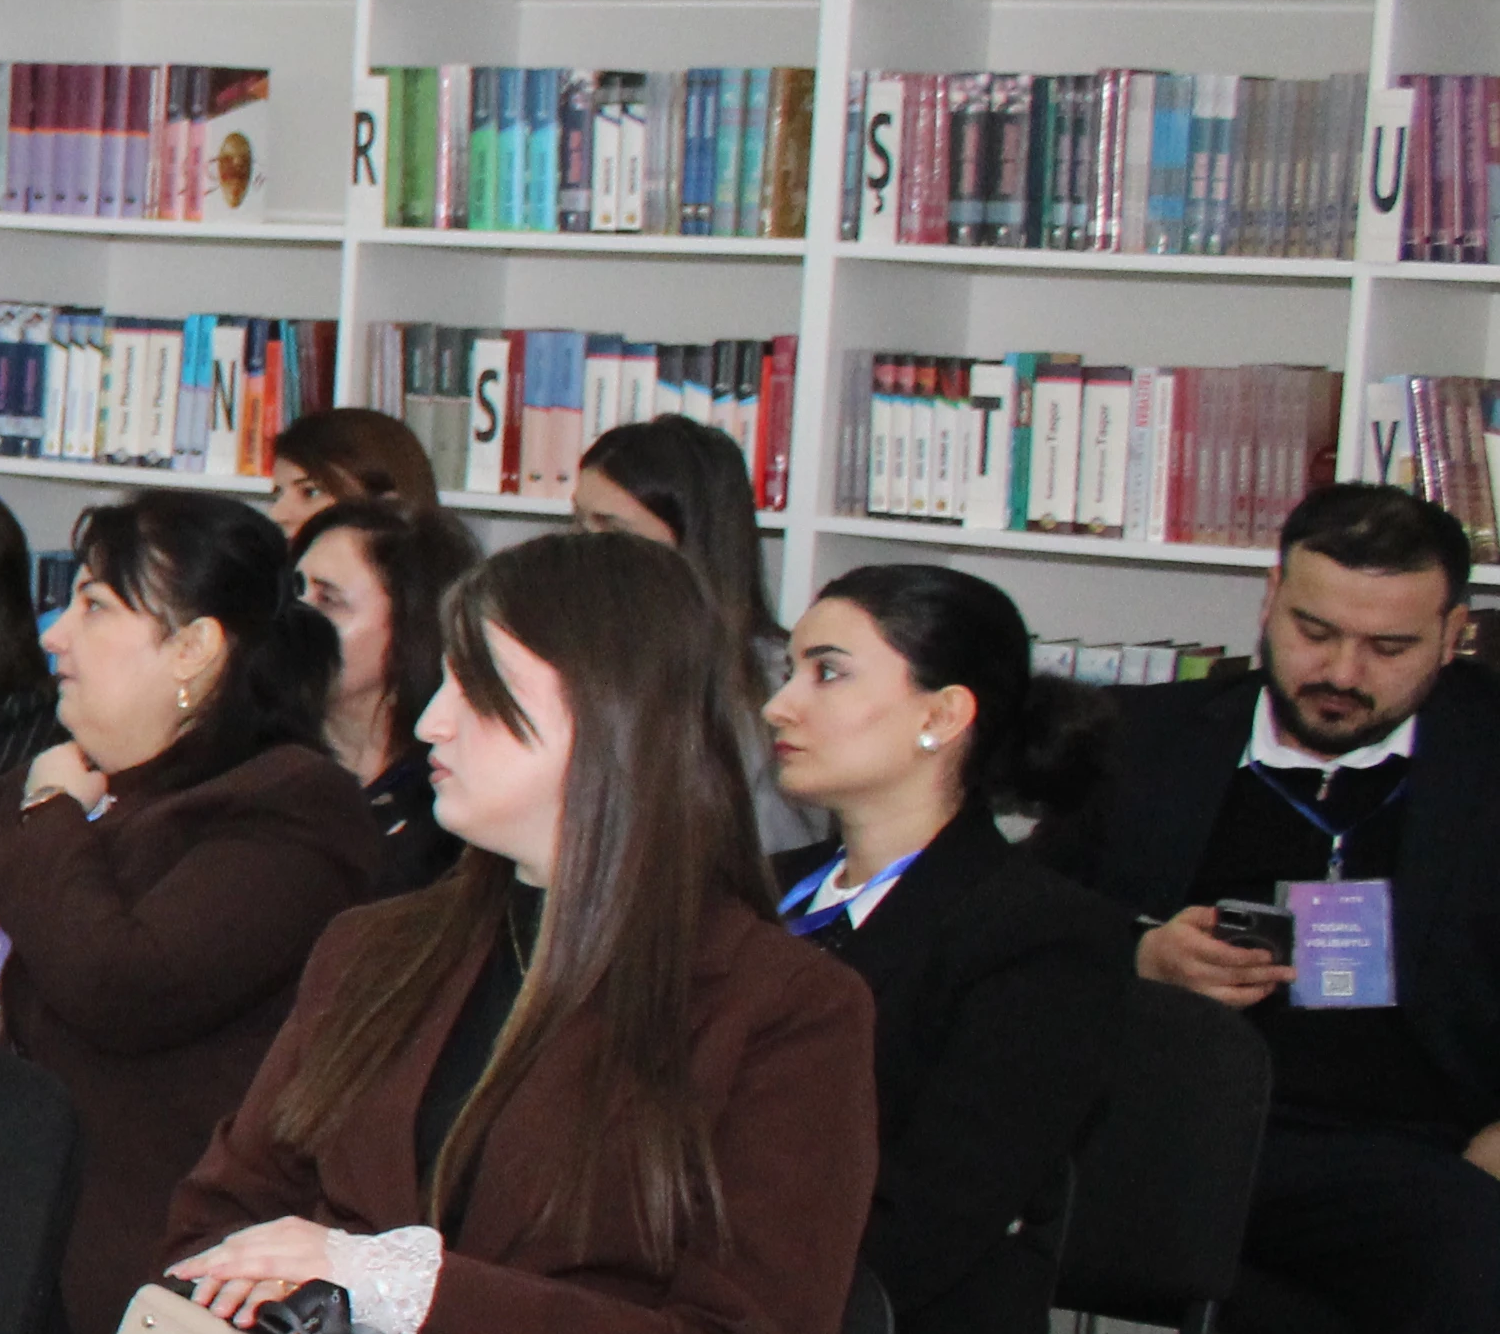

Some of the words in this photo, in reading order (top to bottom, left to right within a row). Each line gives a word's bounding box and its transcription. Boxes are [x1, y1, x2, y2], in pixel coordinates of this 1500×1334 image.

[353, 112, 377, 186] R
[866, 113, 892, 214] Ş
[1368, 125, 1406, 213] U
[213, 360, 235, 432] N
[475, 370, 500, 443] S
[971, 396, 1001, 476] T
[1371, 418, 1400, 482] Y
